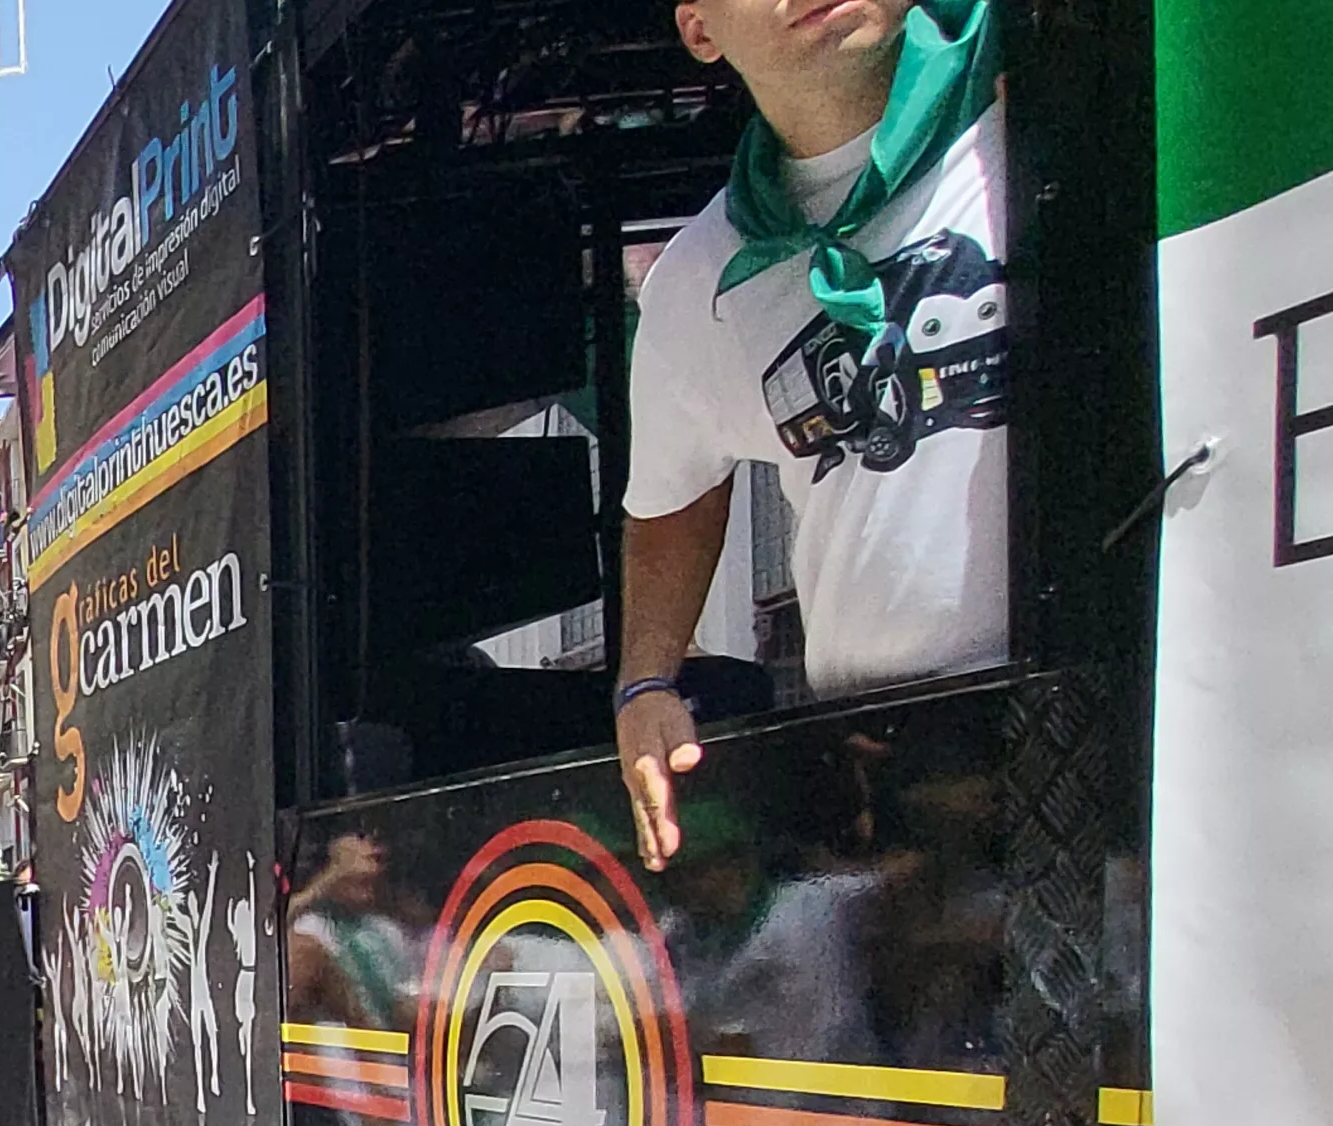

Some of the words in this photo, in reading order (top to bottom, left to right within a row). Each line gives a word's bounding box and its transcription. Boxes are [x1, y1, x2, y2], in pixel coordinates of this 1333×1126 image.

[46, 64, 238, 352] DigitalPrint
[132, 262, 144, 293] de
[144, 206, 199, 279] impresión
[200, 154, 240, 220] digital
[157, 247, 190, 302] visual
[30, 343, 259, 562] www.digitalprinthuesca.es
[80, 552, 248, 697] carmen
[146, 531, 181, 588] del
